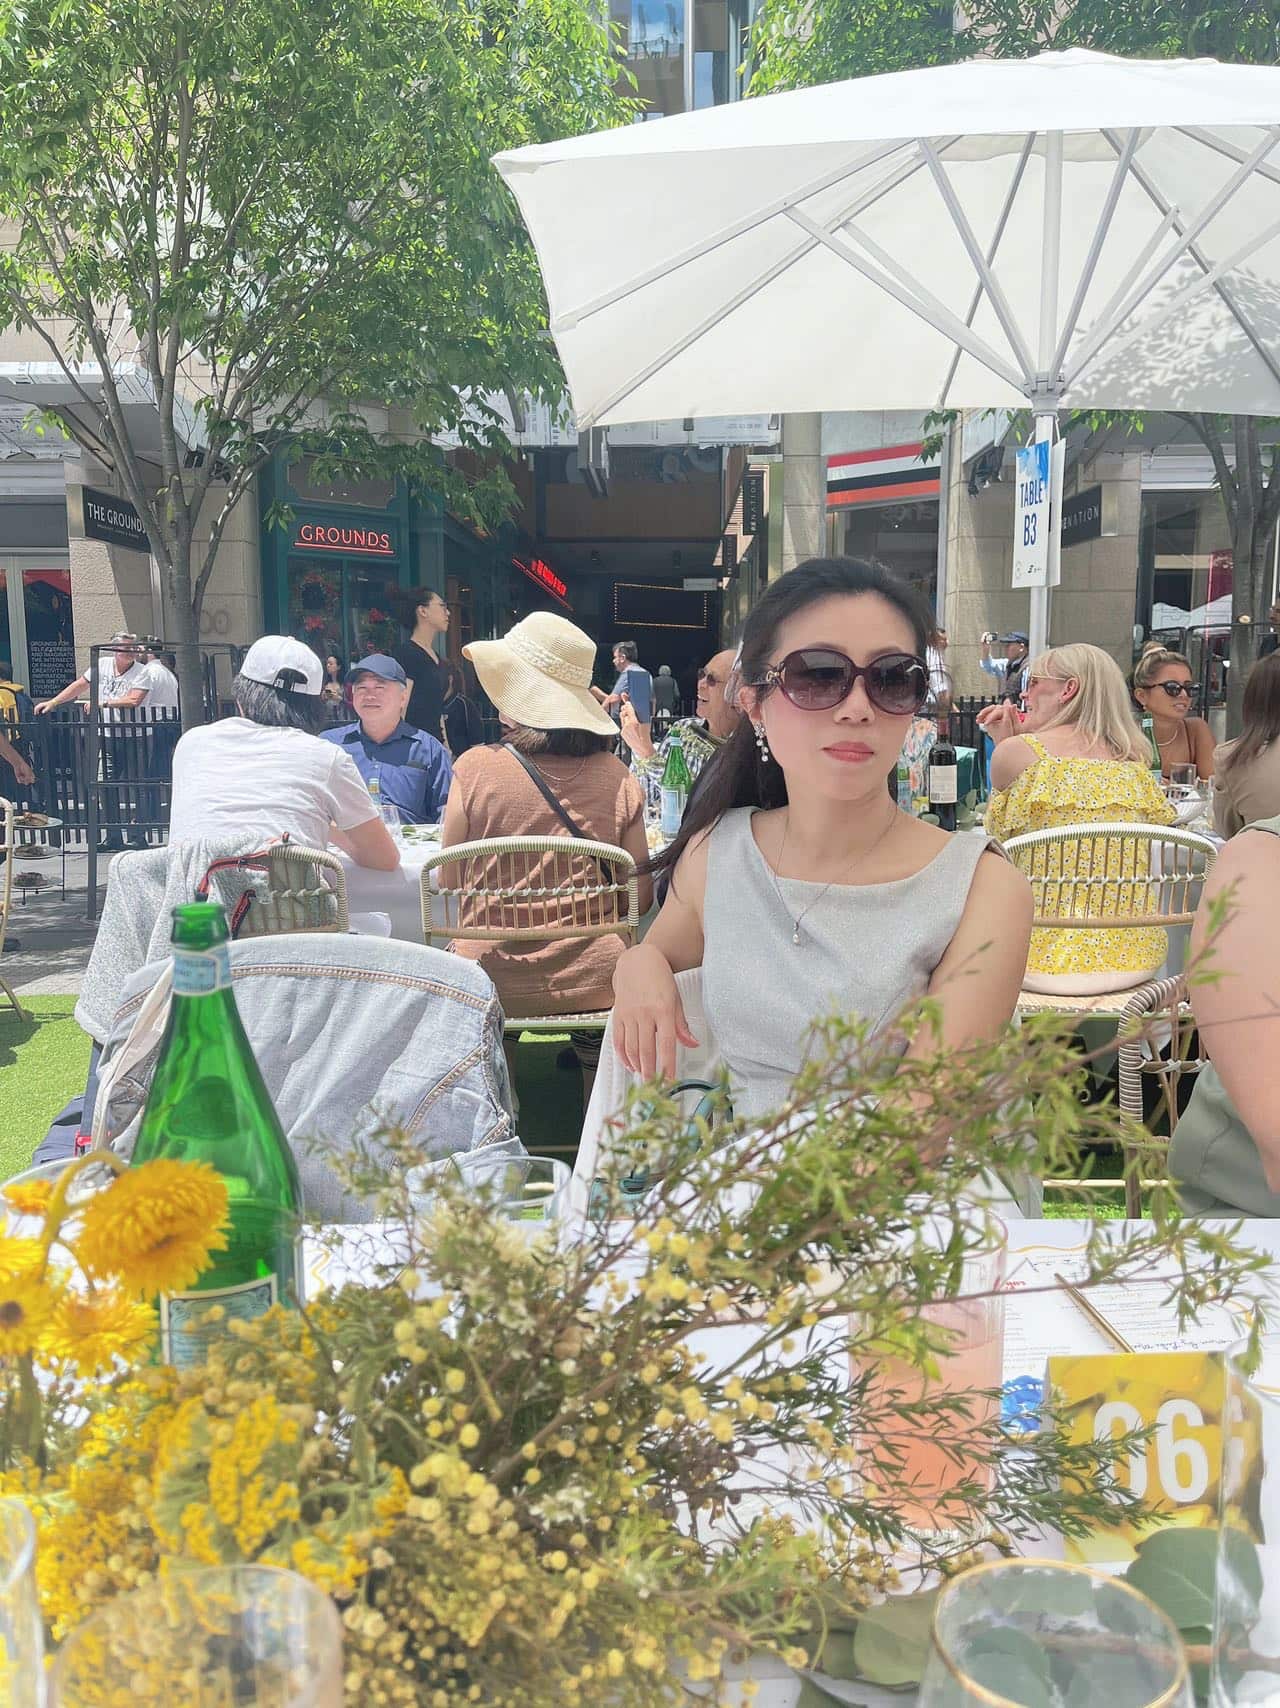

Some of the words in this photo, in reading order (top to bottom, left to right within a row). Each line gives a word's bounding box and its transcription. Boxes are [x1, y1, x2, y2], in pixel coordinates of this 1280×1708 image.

[1020, 477, 1043, 509] TABLE
[87, 502, 105, 522] THE
[1062, 503, 1100, 530] ENATION
[300, 524, 390, 549] GROUNDS
[1023, 513, 1038, 547] B3
[1094, 1398, 1209, 1503] 06
